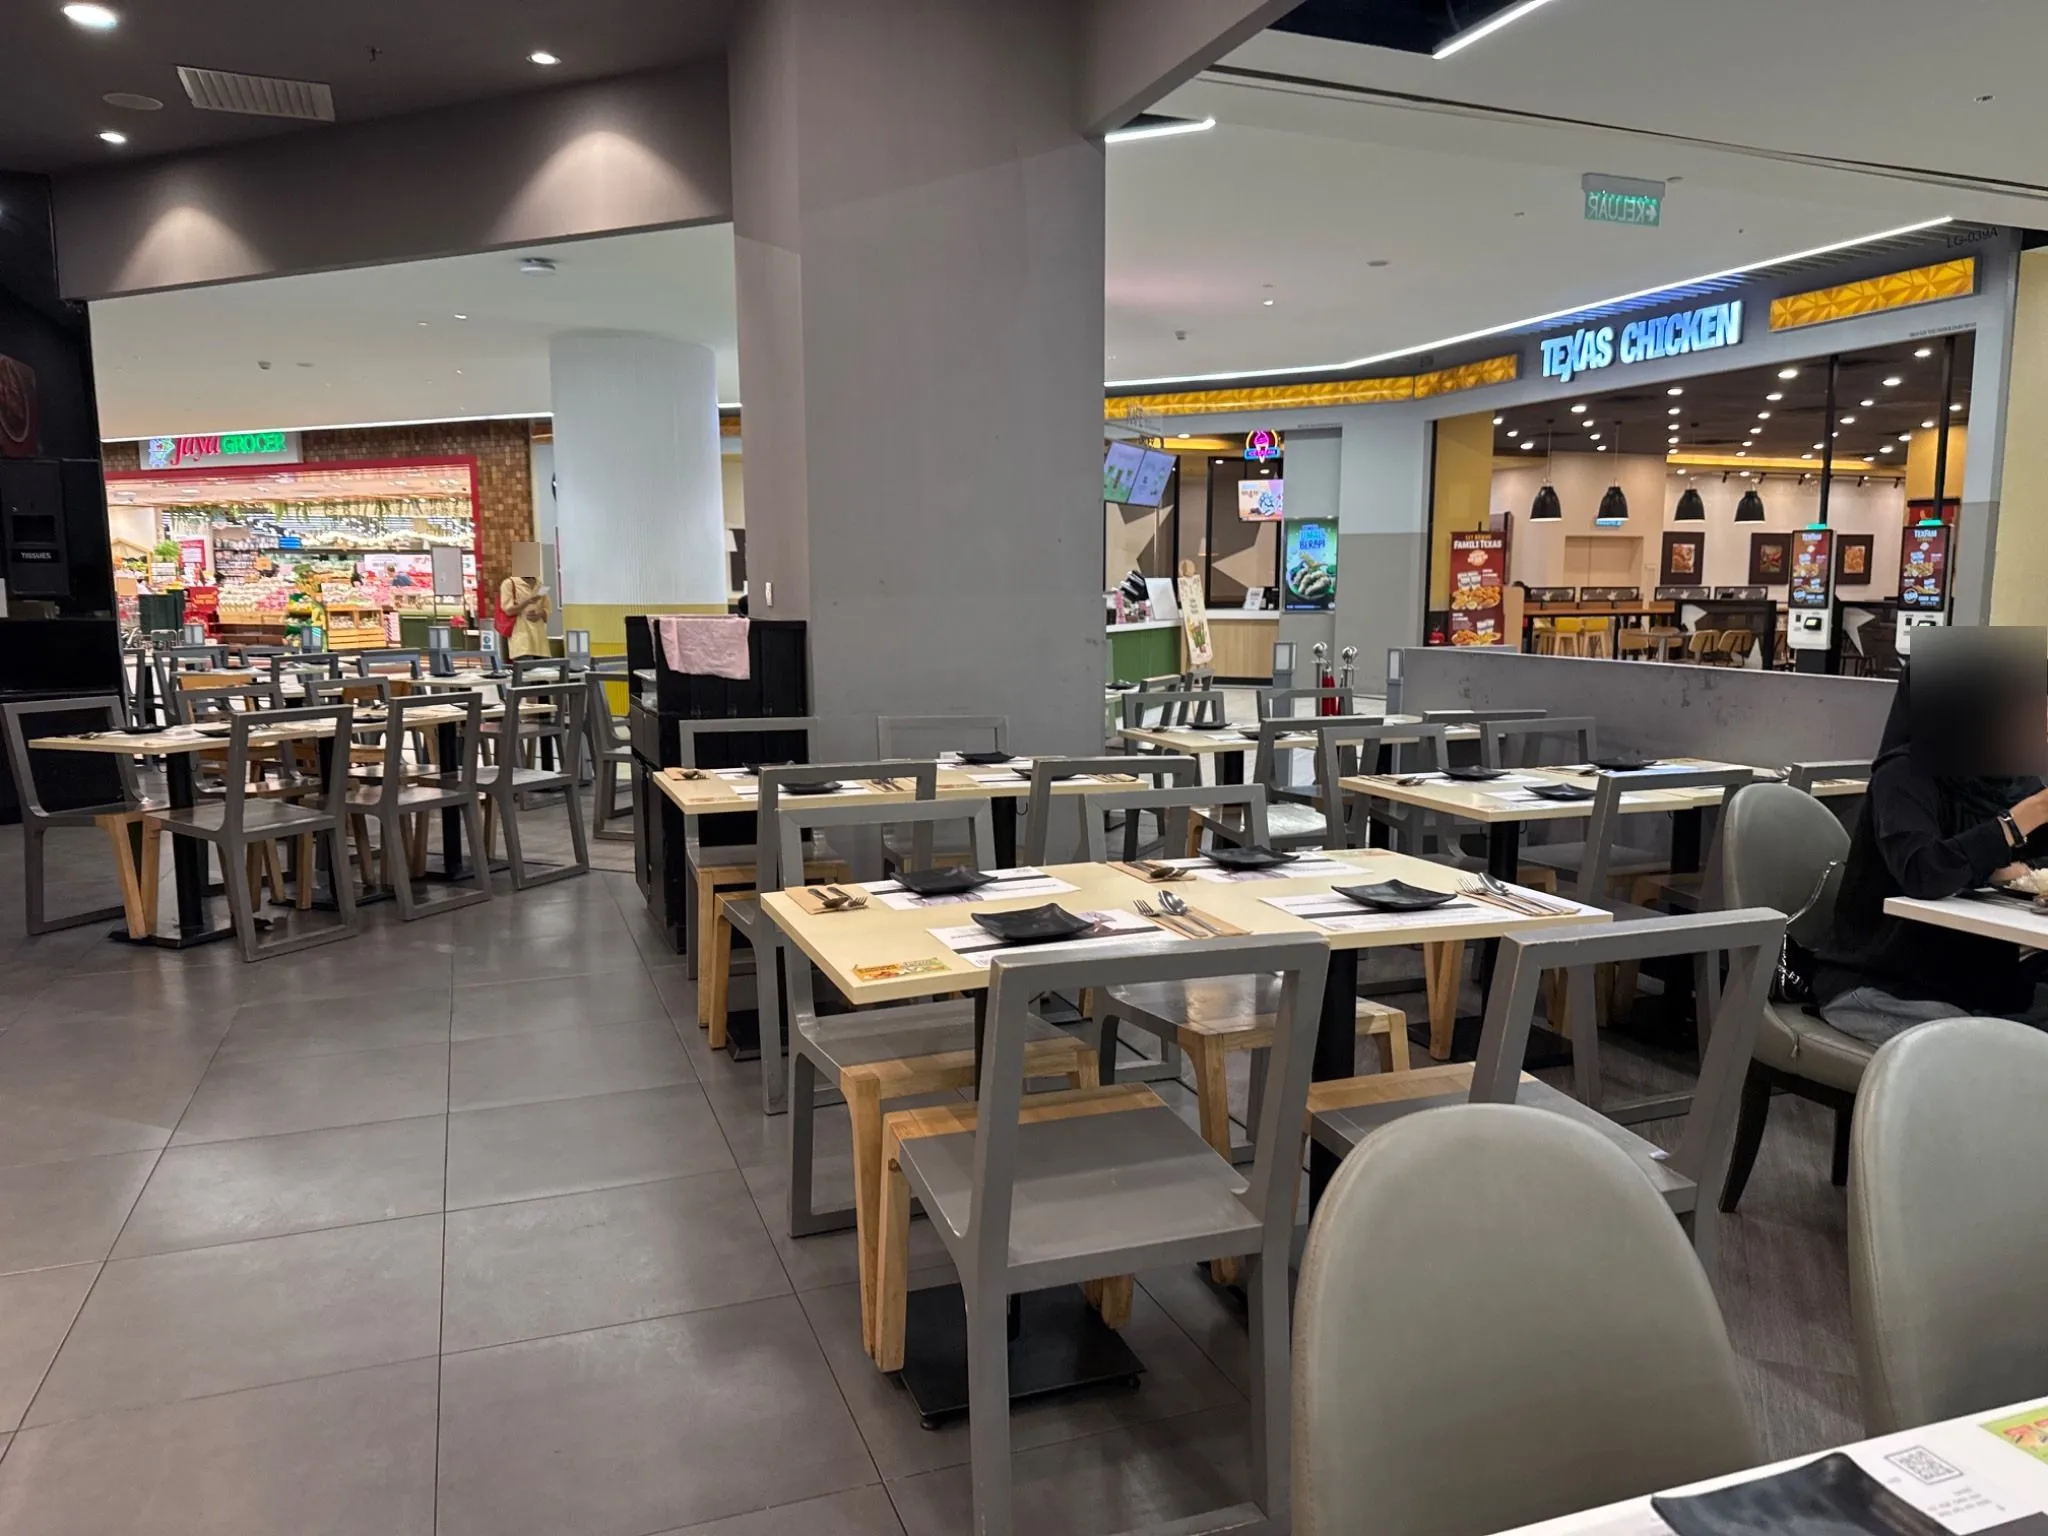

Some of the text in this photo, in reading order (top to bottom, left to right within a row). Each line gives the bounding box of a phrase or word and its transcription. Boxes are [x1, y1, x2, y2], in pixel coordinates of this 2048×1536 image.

[1540, 300, 1742, 383] TEXAS CHICKEN
[221, 431, 287, 454] GROCER
[20, 551, 52, 560] TISSUES
